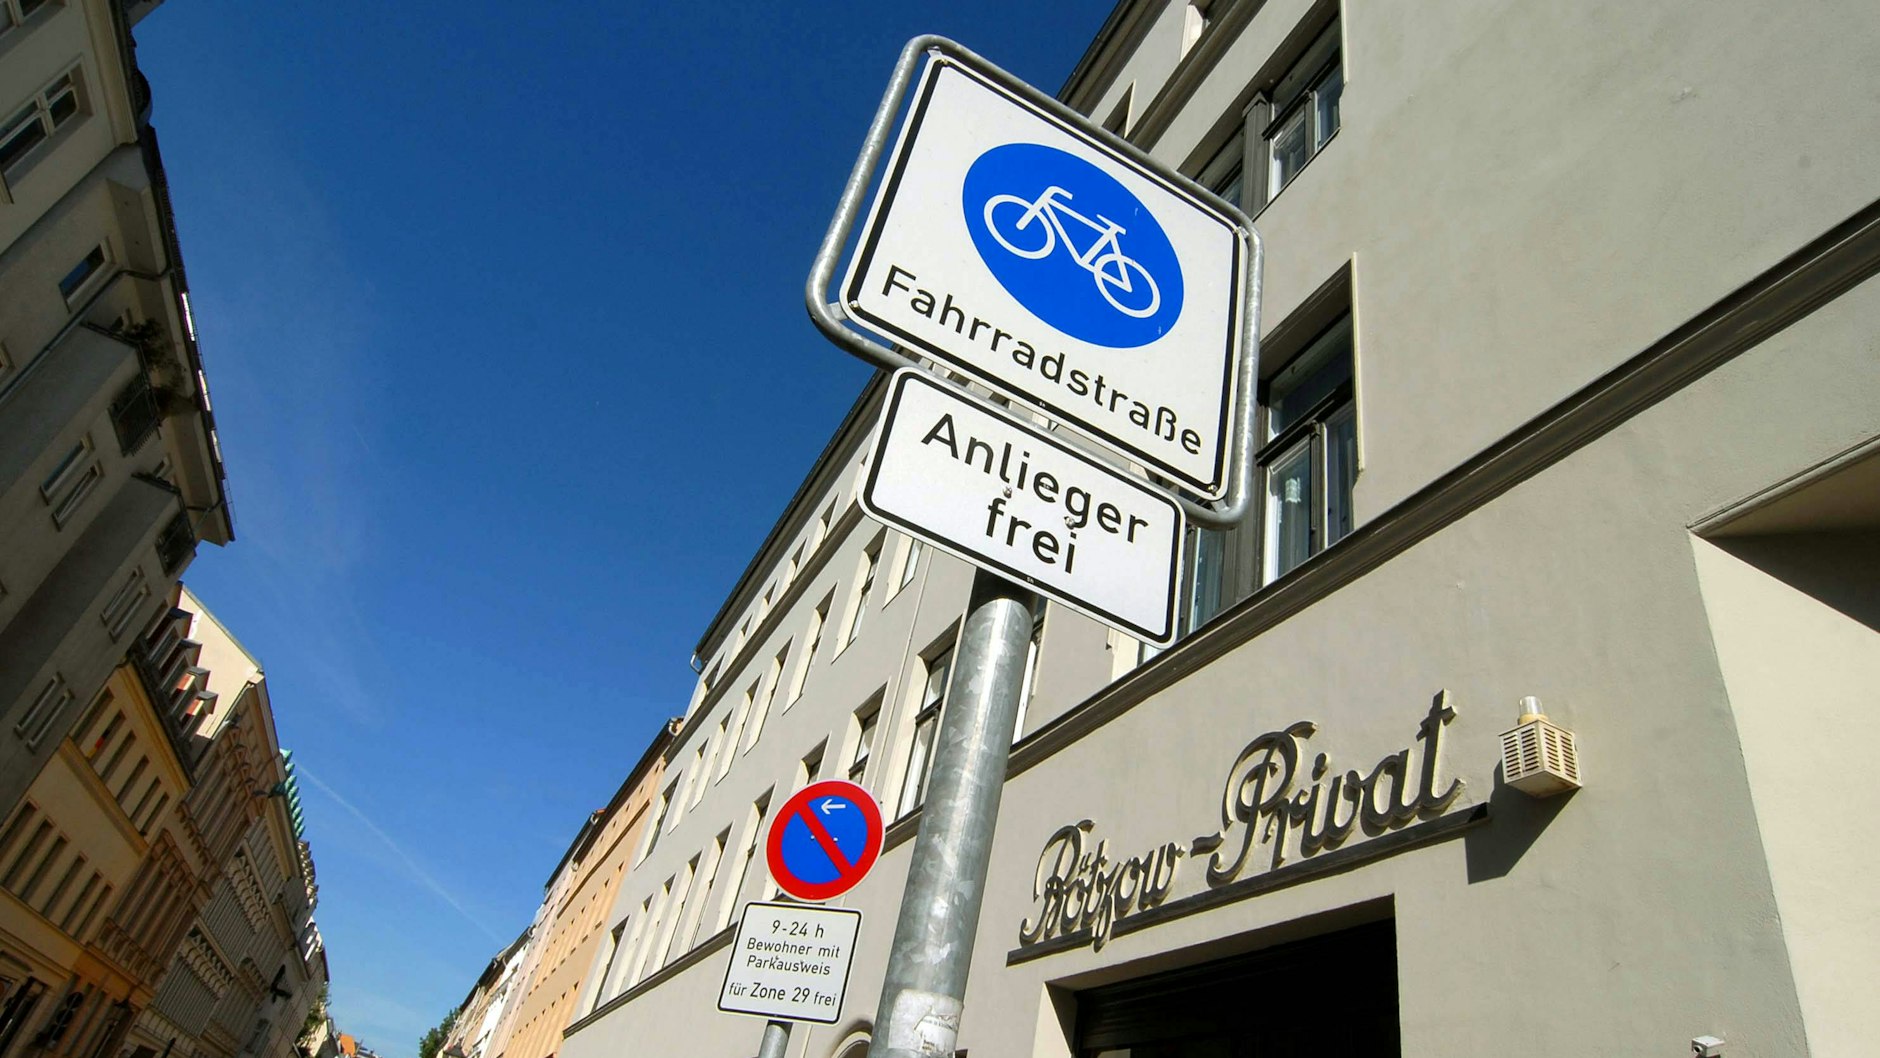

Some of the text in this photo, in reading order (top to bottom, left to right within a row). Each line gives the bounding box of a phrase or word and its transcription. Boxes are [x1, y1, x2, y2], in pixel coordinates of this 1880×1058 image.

[882, 264, 1201, 456] Fahrradstraße
[921, 413, 1149, 543] Anlieger
[986, 497, 1077, 574] frei
[772, 919, 824, 939] 9-24 h
[746, 937, 840, 958] Bewohner mit
[746, 954, 831, 976] Parkausweis
[728, 982, 837, 1007] für Zone 29 frei
